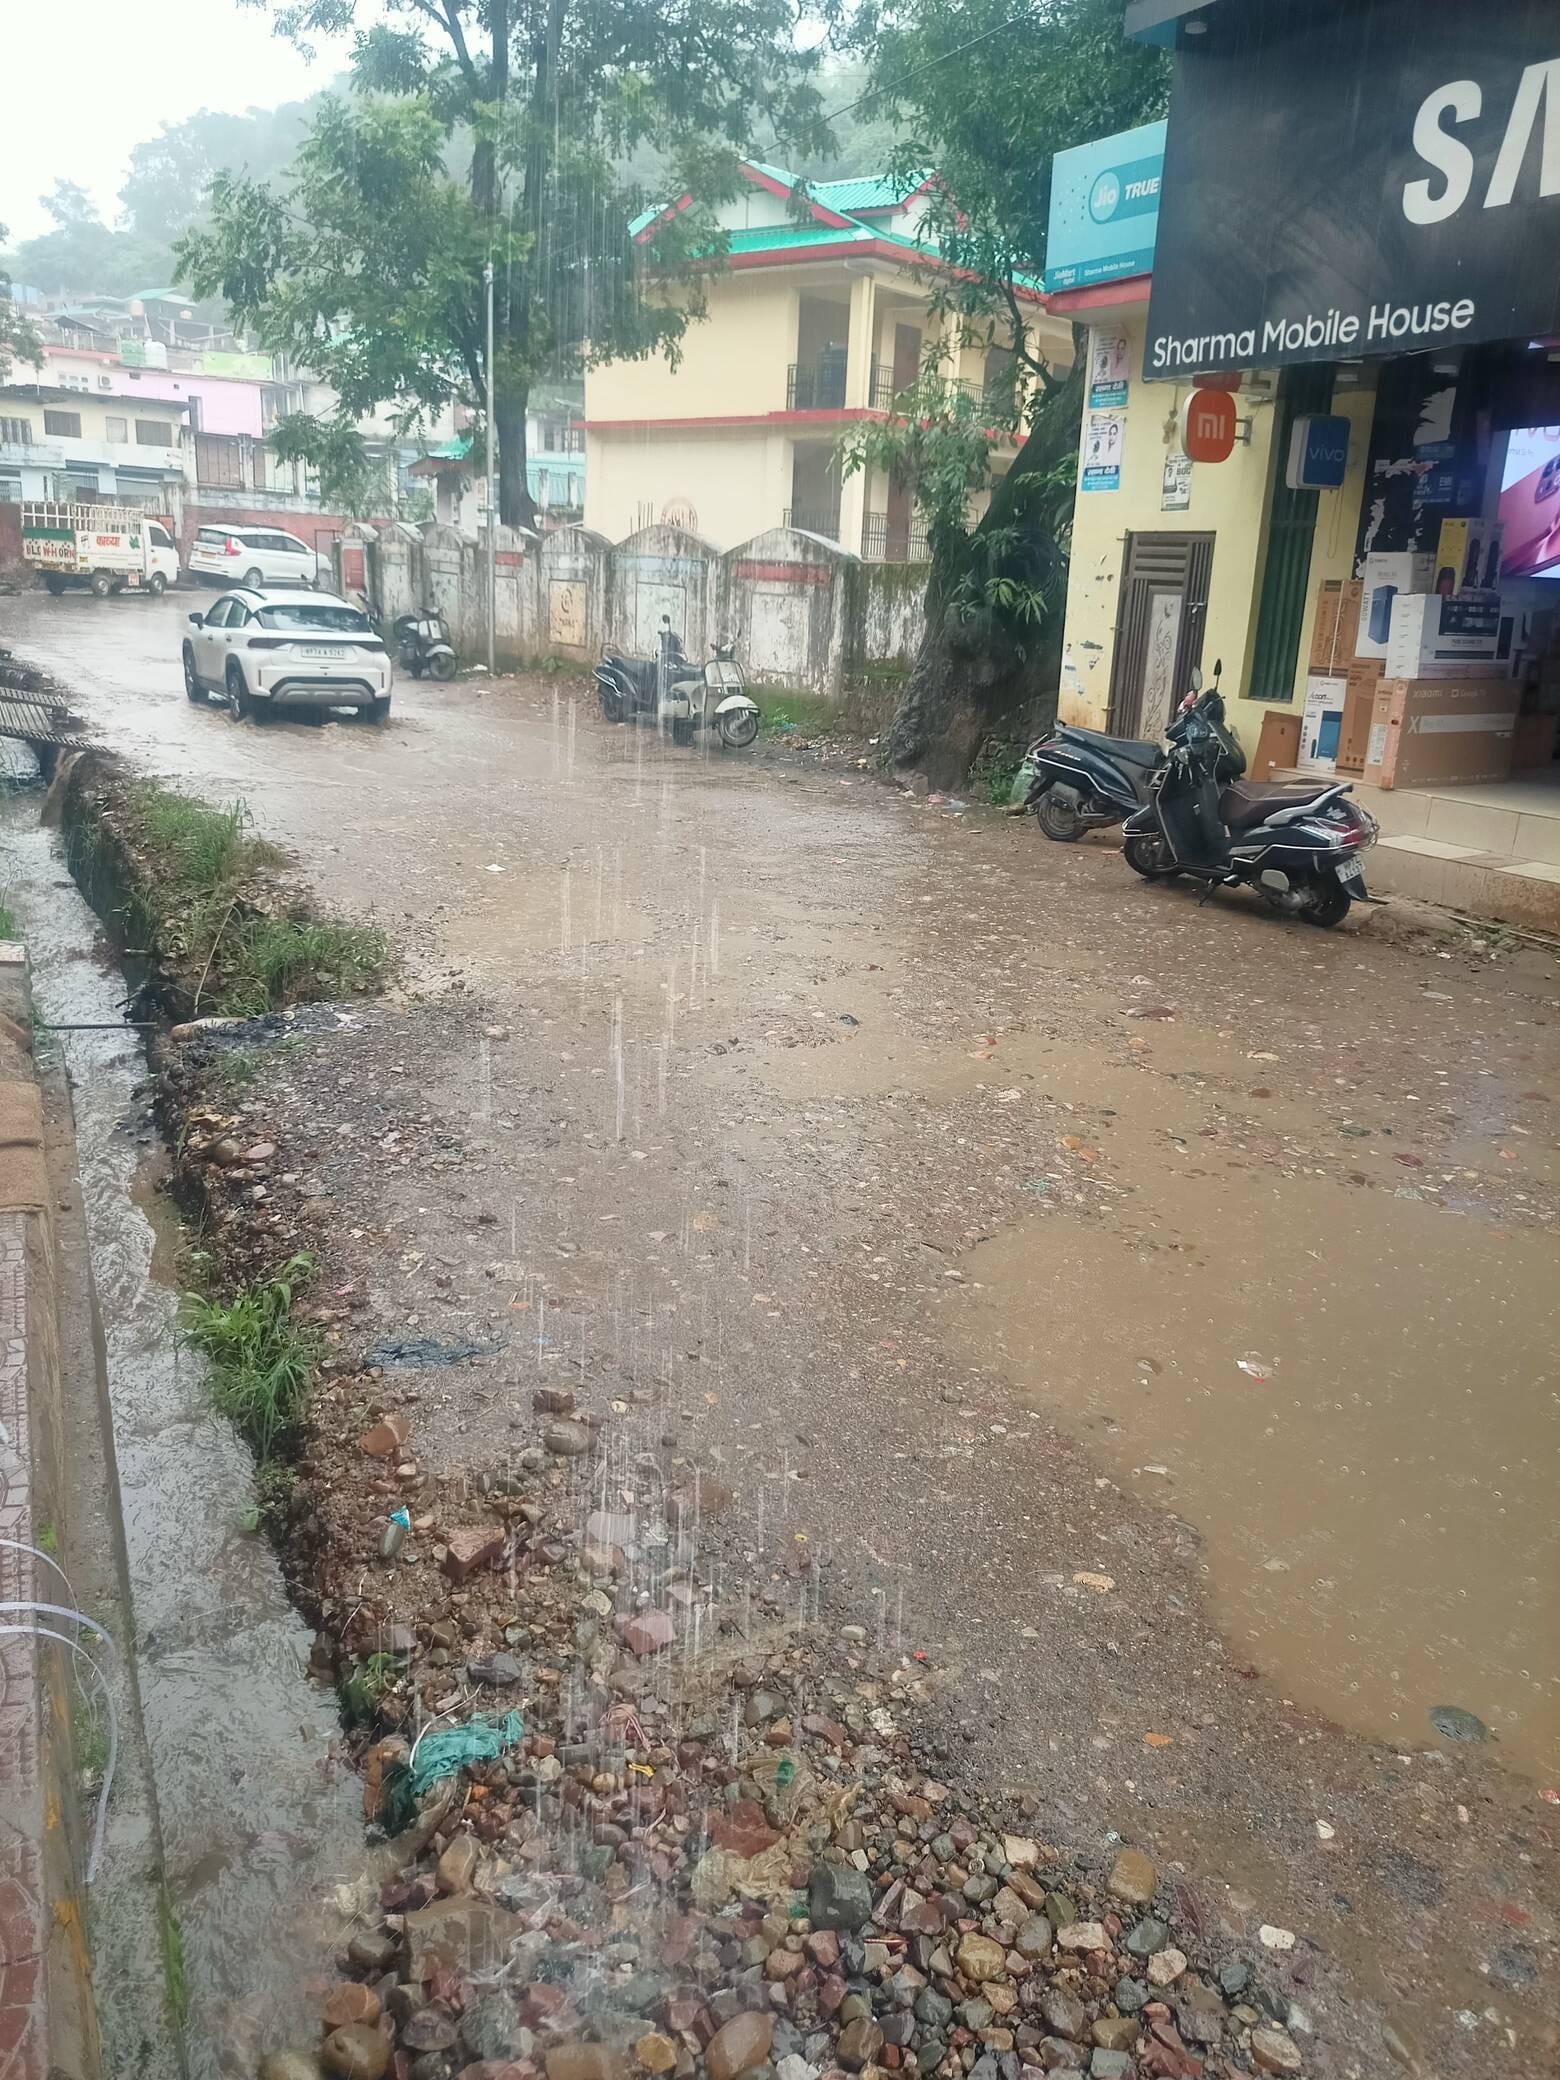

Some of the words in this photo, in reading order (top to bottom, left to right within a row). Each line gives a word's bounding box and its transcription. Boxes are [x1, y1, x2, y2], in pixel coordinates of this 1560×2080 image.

[1094, 185, 1117, 208] Jio
[1124, 176, 1160, 200] TRUE
[1152, 329, 1256, 368] Sharma
[1261, 308, 1359, 353] Mobile
[1366, 298, 1475, 340] House
[1309, 444, 1345, 462] vivo
[1412, 688, 1443, 698] xiaomi
